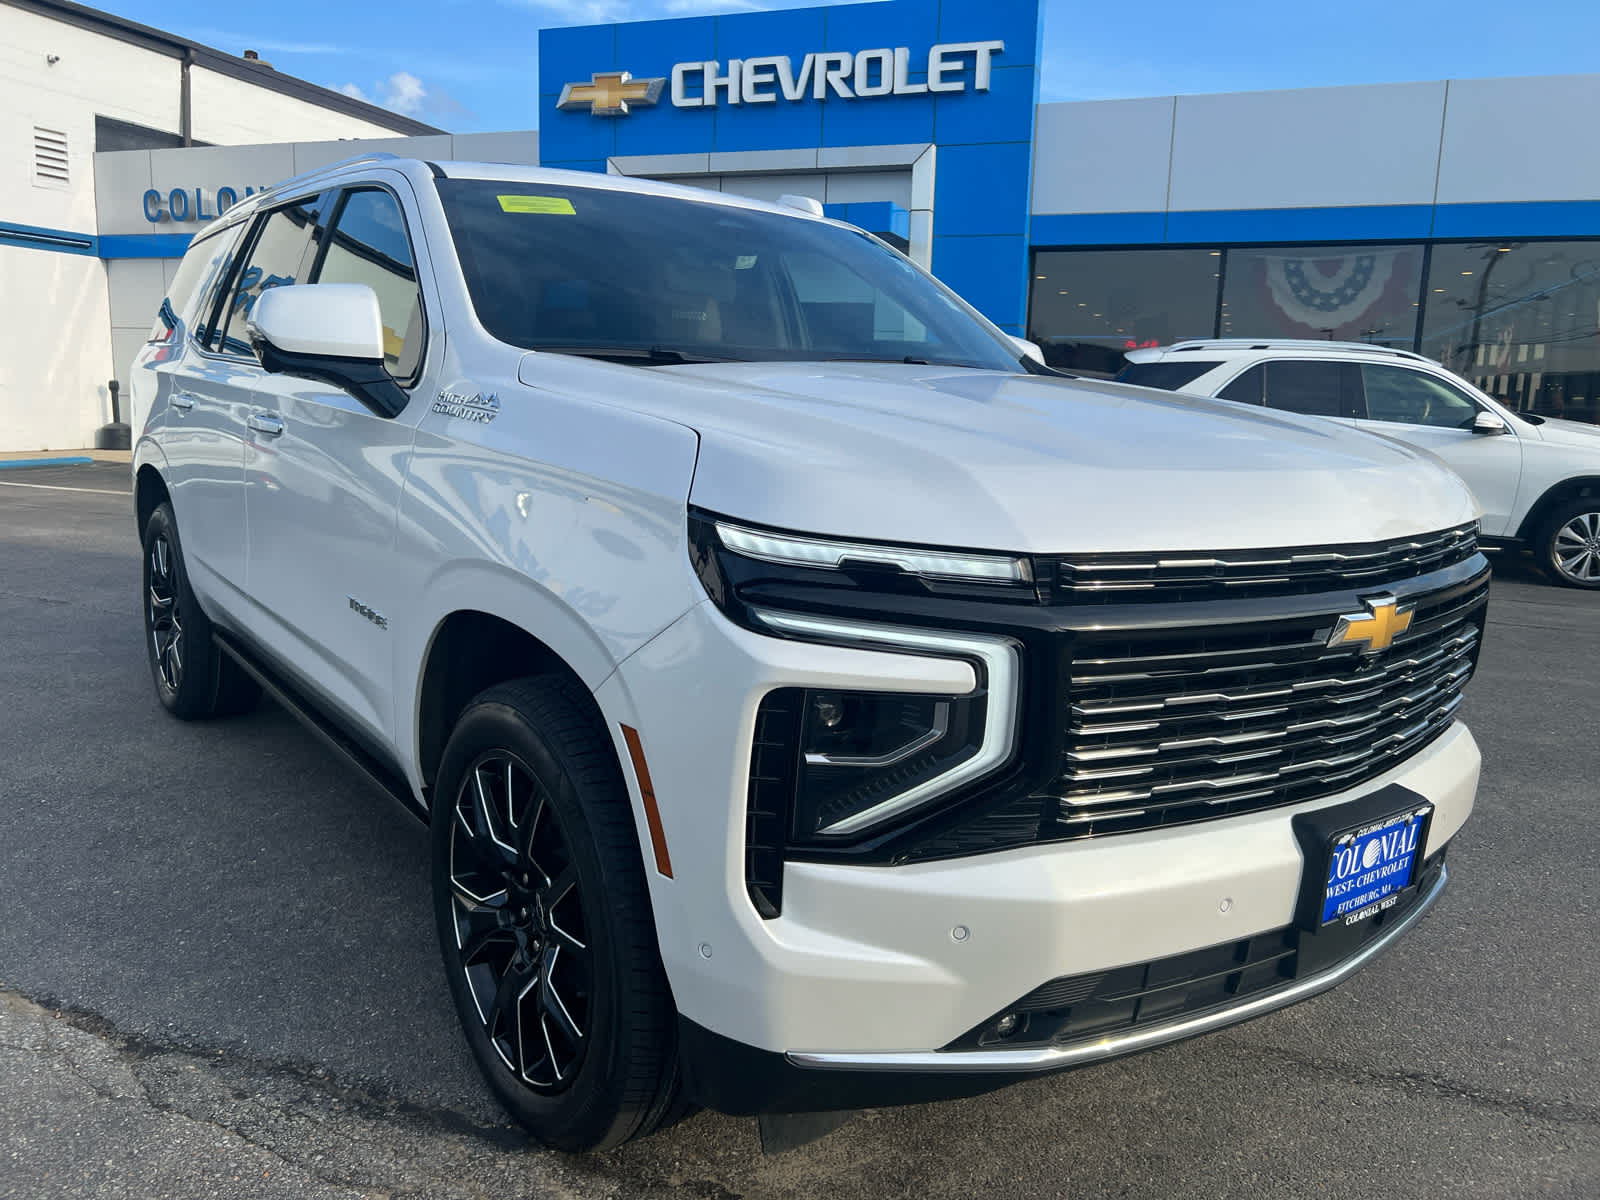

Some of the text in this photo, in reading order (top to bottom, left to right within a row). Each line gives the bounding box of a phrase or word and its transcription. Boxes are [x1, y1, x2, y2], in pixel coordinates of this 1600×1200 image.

[671, 40, 1004, 107] CHEVROLET
[143, 186, 265, 222] COLO
[432, 403, 497, 424] COUNTRY
[437, 391, 465, 405] HIGH
[1345, 895, 1398, 926] COLONIAL WEST
